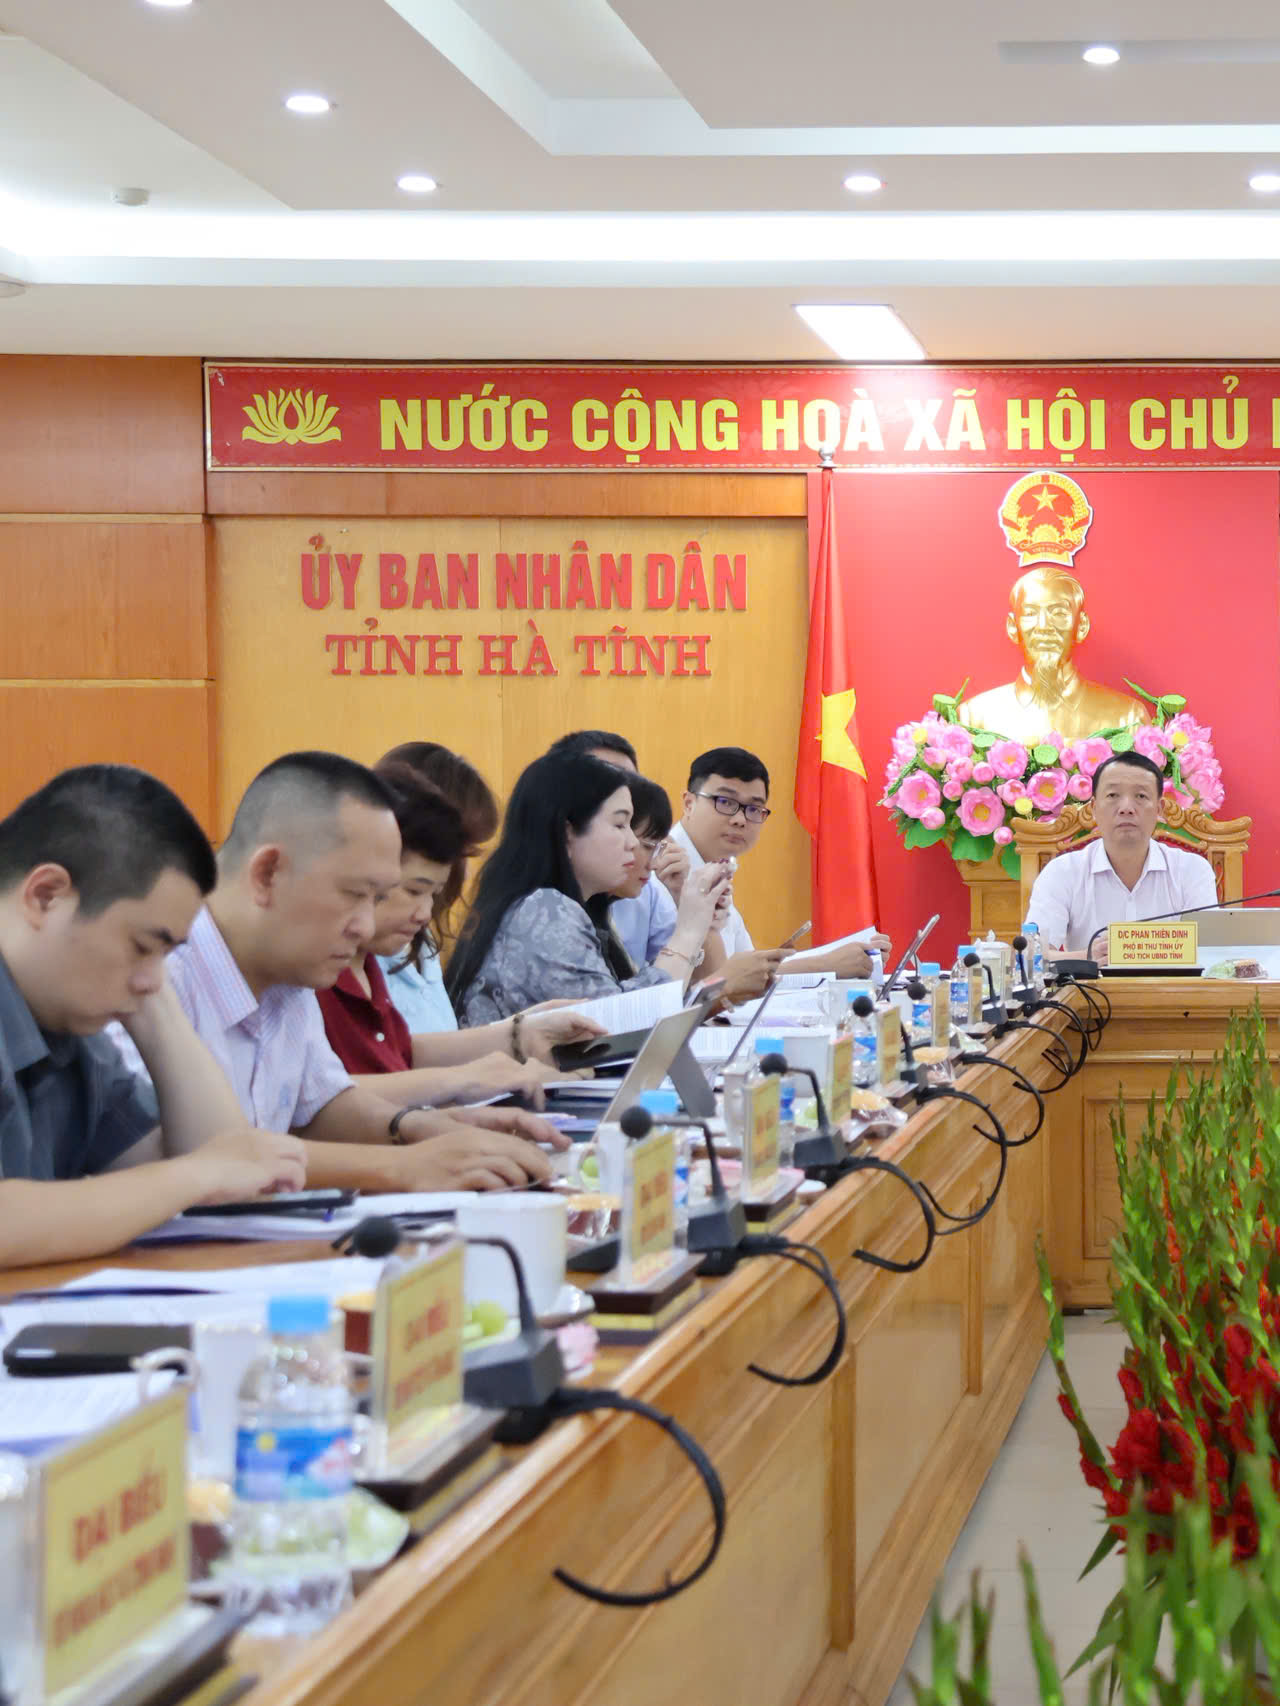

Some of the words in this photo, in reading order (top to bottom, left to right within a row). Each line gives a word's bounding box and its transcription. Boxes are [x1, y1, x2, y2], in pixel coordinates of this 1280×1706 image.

[380, 383, 550, 453] NƯỚC
[571, 388, 739, 463] CỘNG
[761, 388, 884, 452] HOÀ
[904, 388, 986, 451] XÃ
[1006, 388, 1106, 462] HỘI
[1129, 375, 1249, 451] CHỦ
[301, 534, 363, 610] ỦY
[380, 553, 479, 609] BAN
[496, 540, 633, 609] NHÂN
[647, 540, 747, 609] DÂN
[326, 617, 463, 675] TỈNH
[479, 619, 558, 675] HÀ
[575, 625, 711, 676] TĨNH
[1131, 930, 1150, 939] PHAN
